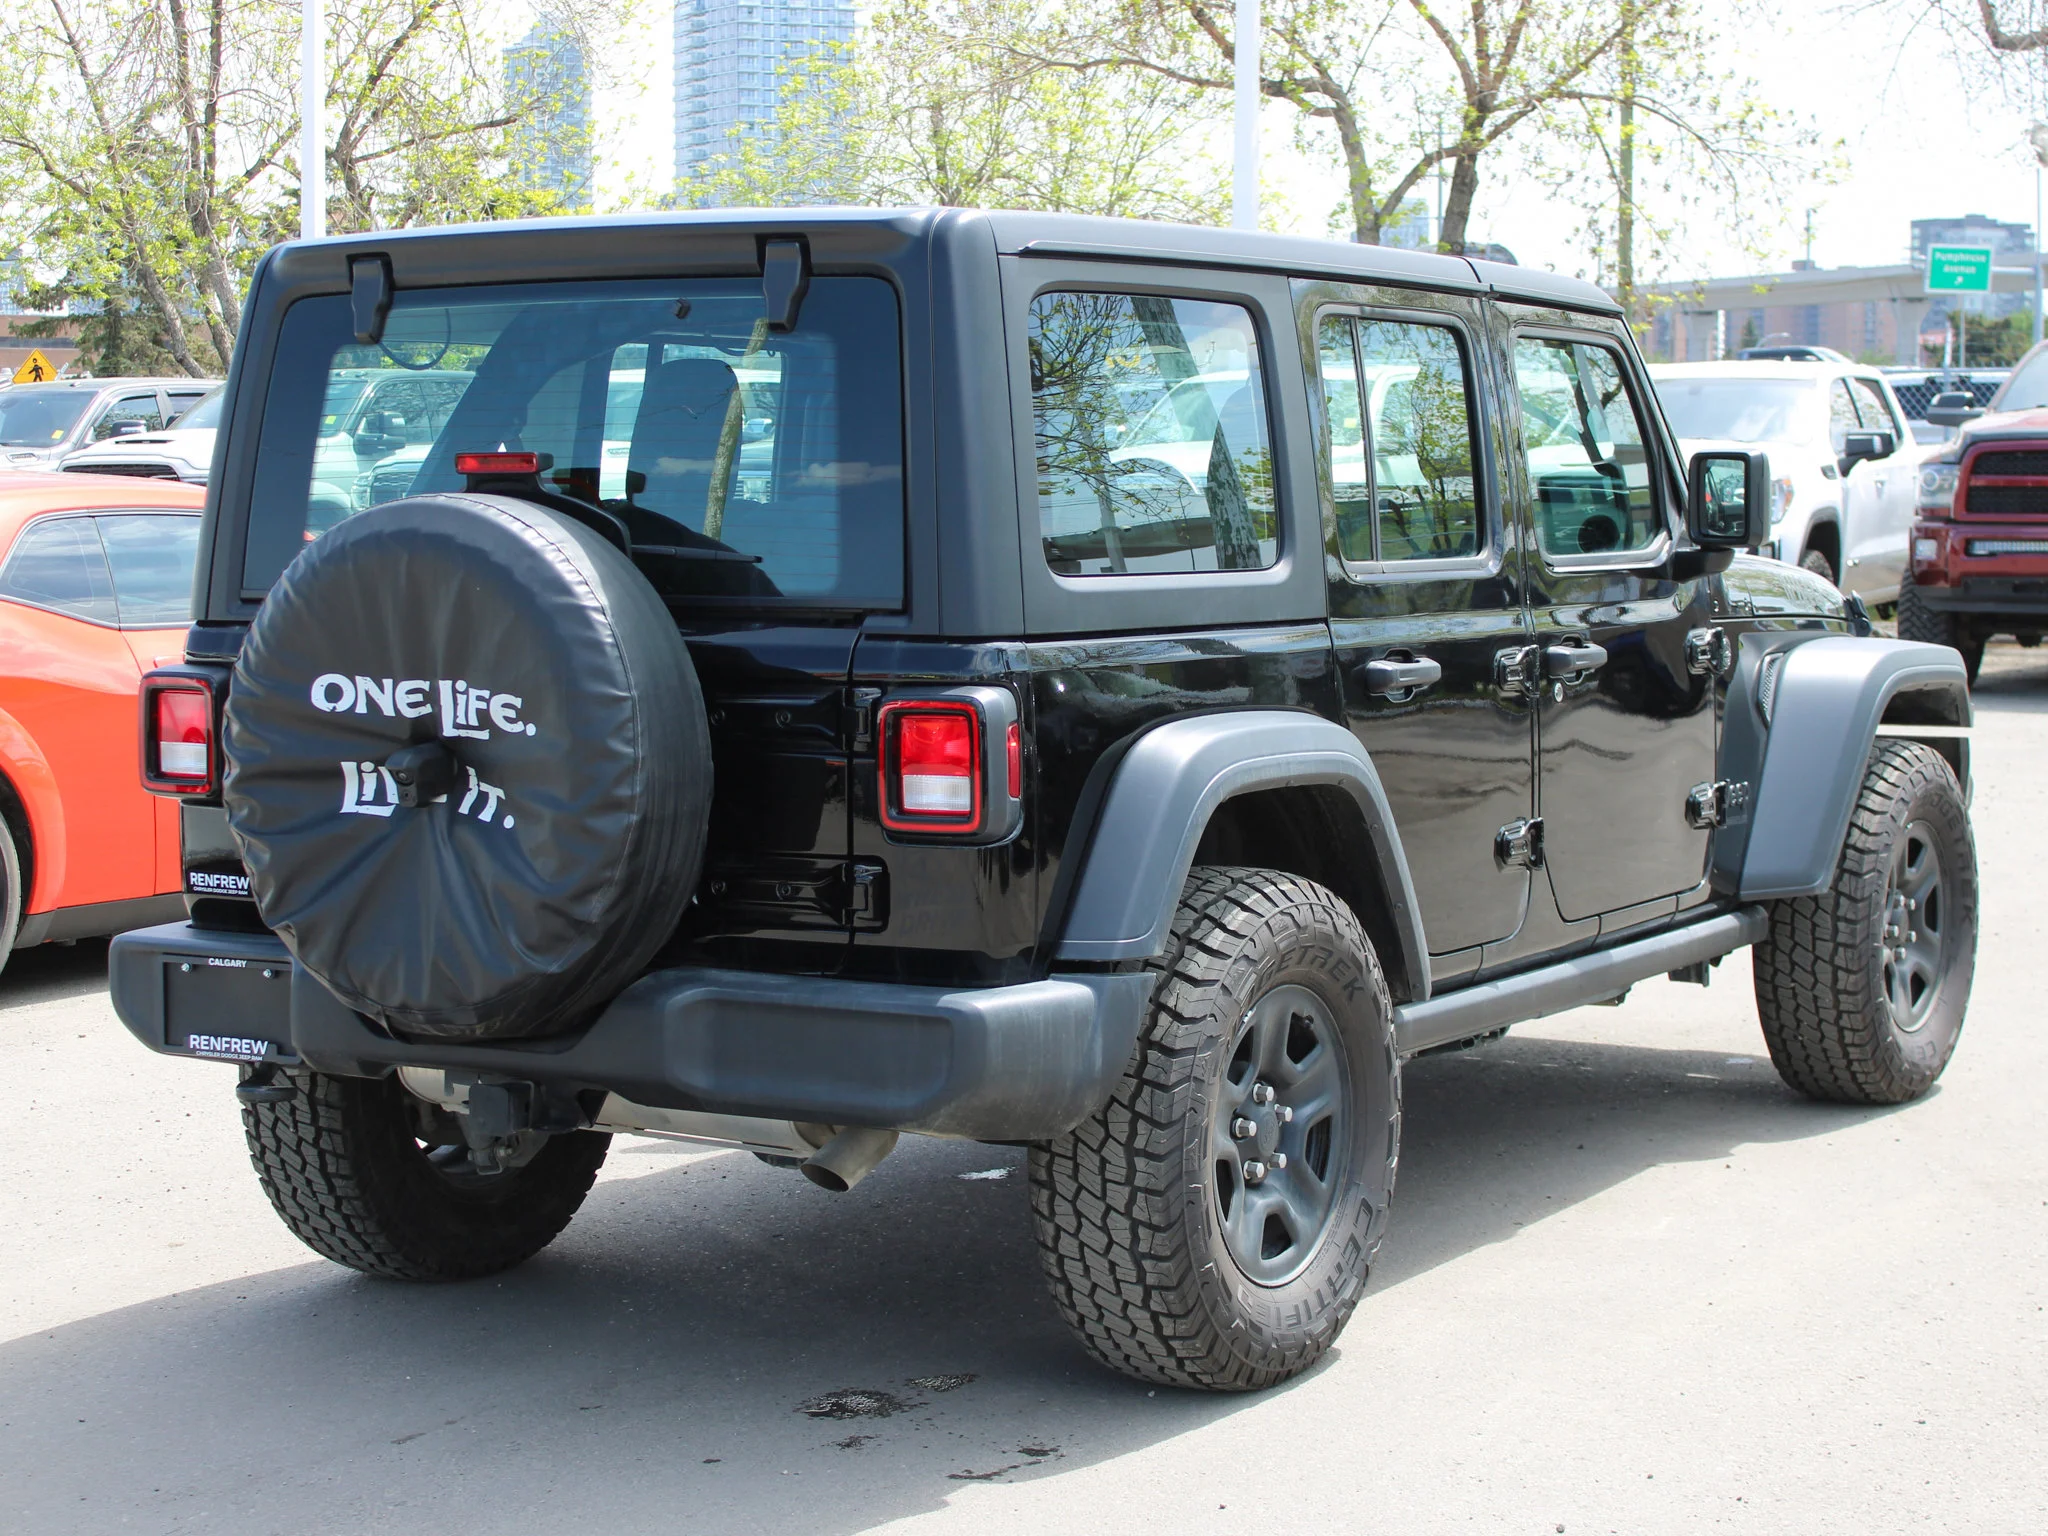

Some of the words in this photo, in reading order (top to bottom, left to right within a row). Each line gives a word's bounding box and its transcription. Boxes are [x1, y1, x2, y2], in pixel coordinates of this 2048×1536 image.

[310, 673, 432, 718] ONE
[190, 872, 250, 890] RENFREW
[208, 957, 247, 968] CALGARY
[190, 1034, 269, 1055] RENFREW
